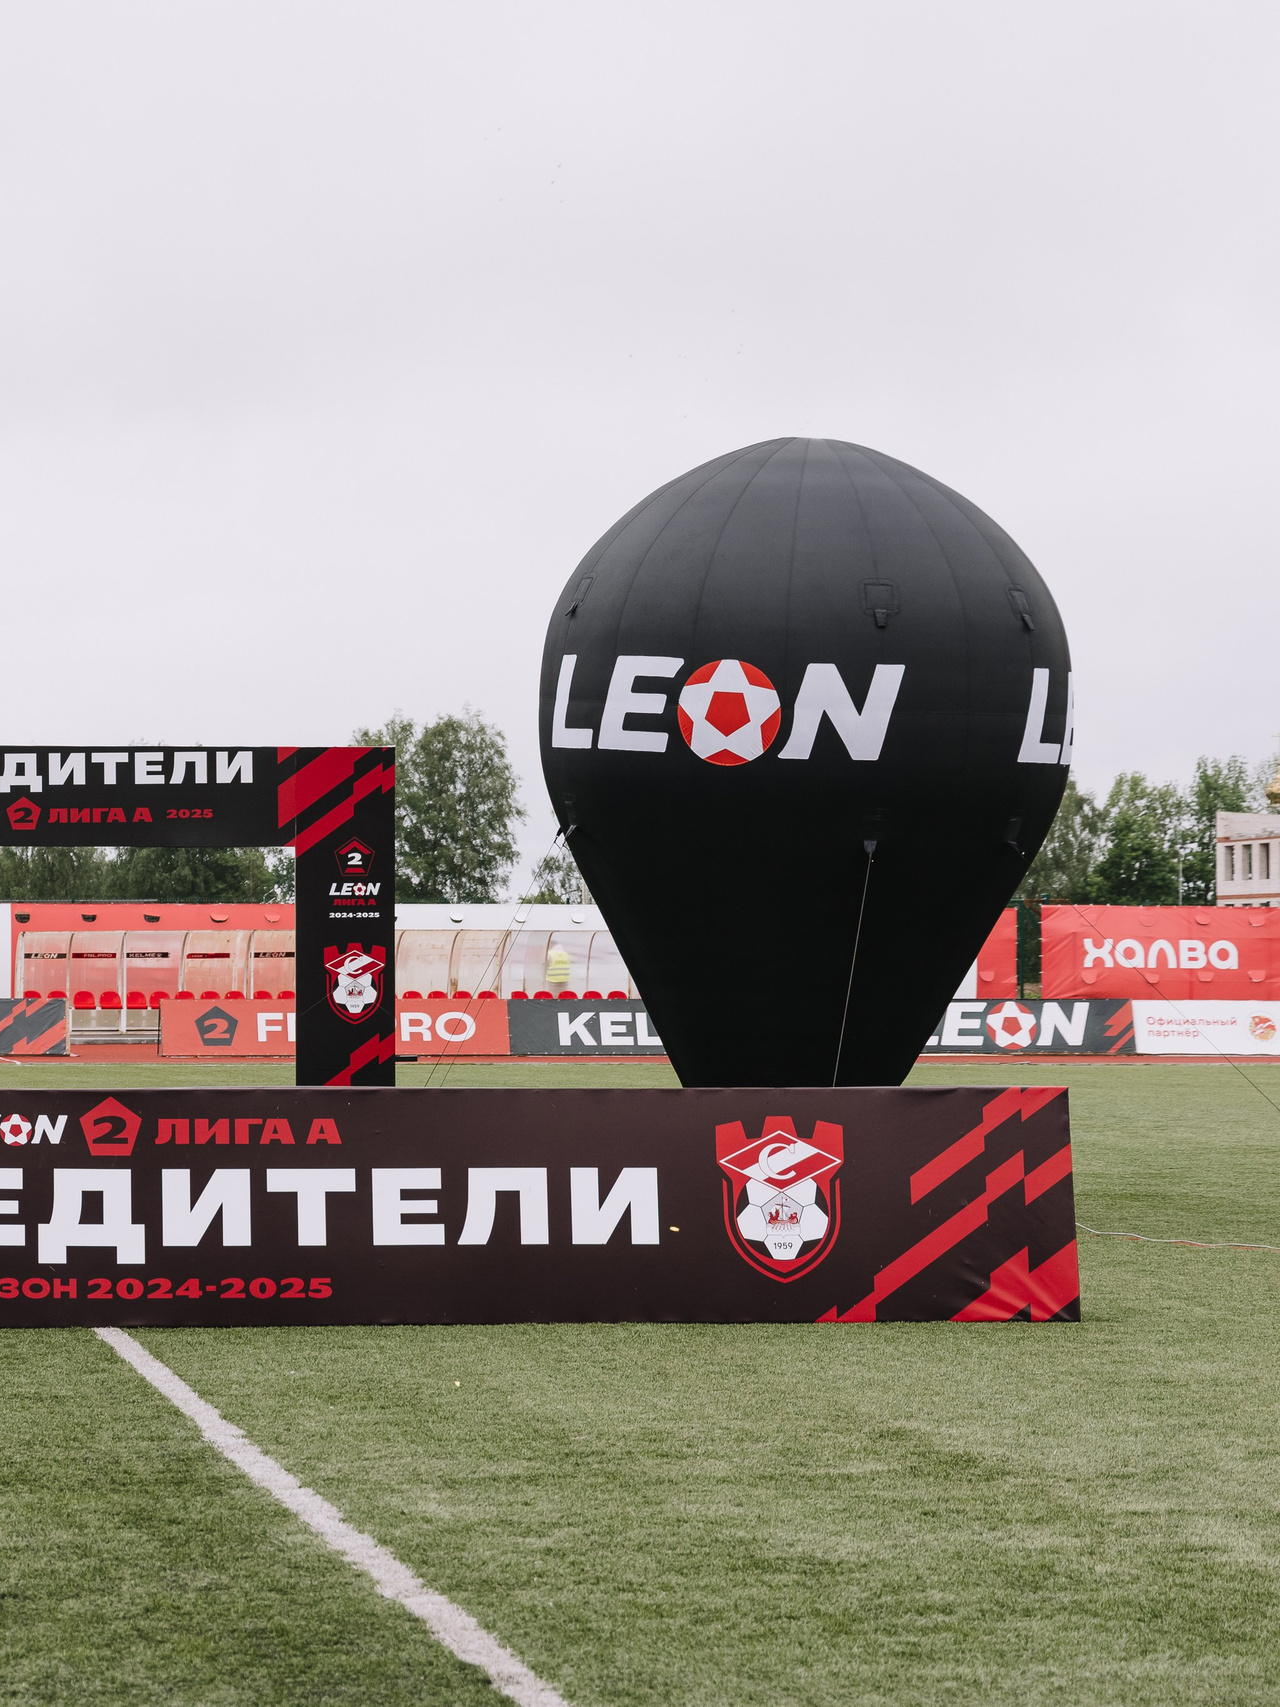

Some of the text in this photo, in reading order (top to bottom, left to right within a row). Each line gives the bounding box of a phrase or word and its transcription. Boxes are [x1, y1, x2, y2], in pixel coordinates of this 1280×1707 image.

[551, 654, 906, 767] LEON
[13, 806, 35, 824] 2
[47, 807, 127, 824] ЛИГА
[132, 807, 153, 824] А
[166, 808, 214, 820] 2025
[346, 852, 363, 866] 2
[328, 882, 381, 897] LEON
[333, 898, 377, 906] ЛИГА А
[203, 1018, 231, 1039] 2
[557, 1012, 664, 1046] KEL
[1146, 1016, 1238, 1027] Официальный
[1147, 1029, 1200, 1038] партнёр
[91, 1115, 129, 1145] 2
[154, 1117, 296, 1145] ЛИГА
[305, 1117, 343, 1145] А
[773, 1242, 794, 1250] 1959
[87, 1276, 334, 1300] 2024-2025
